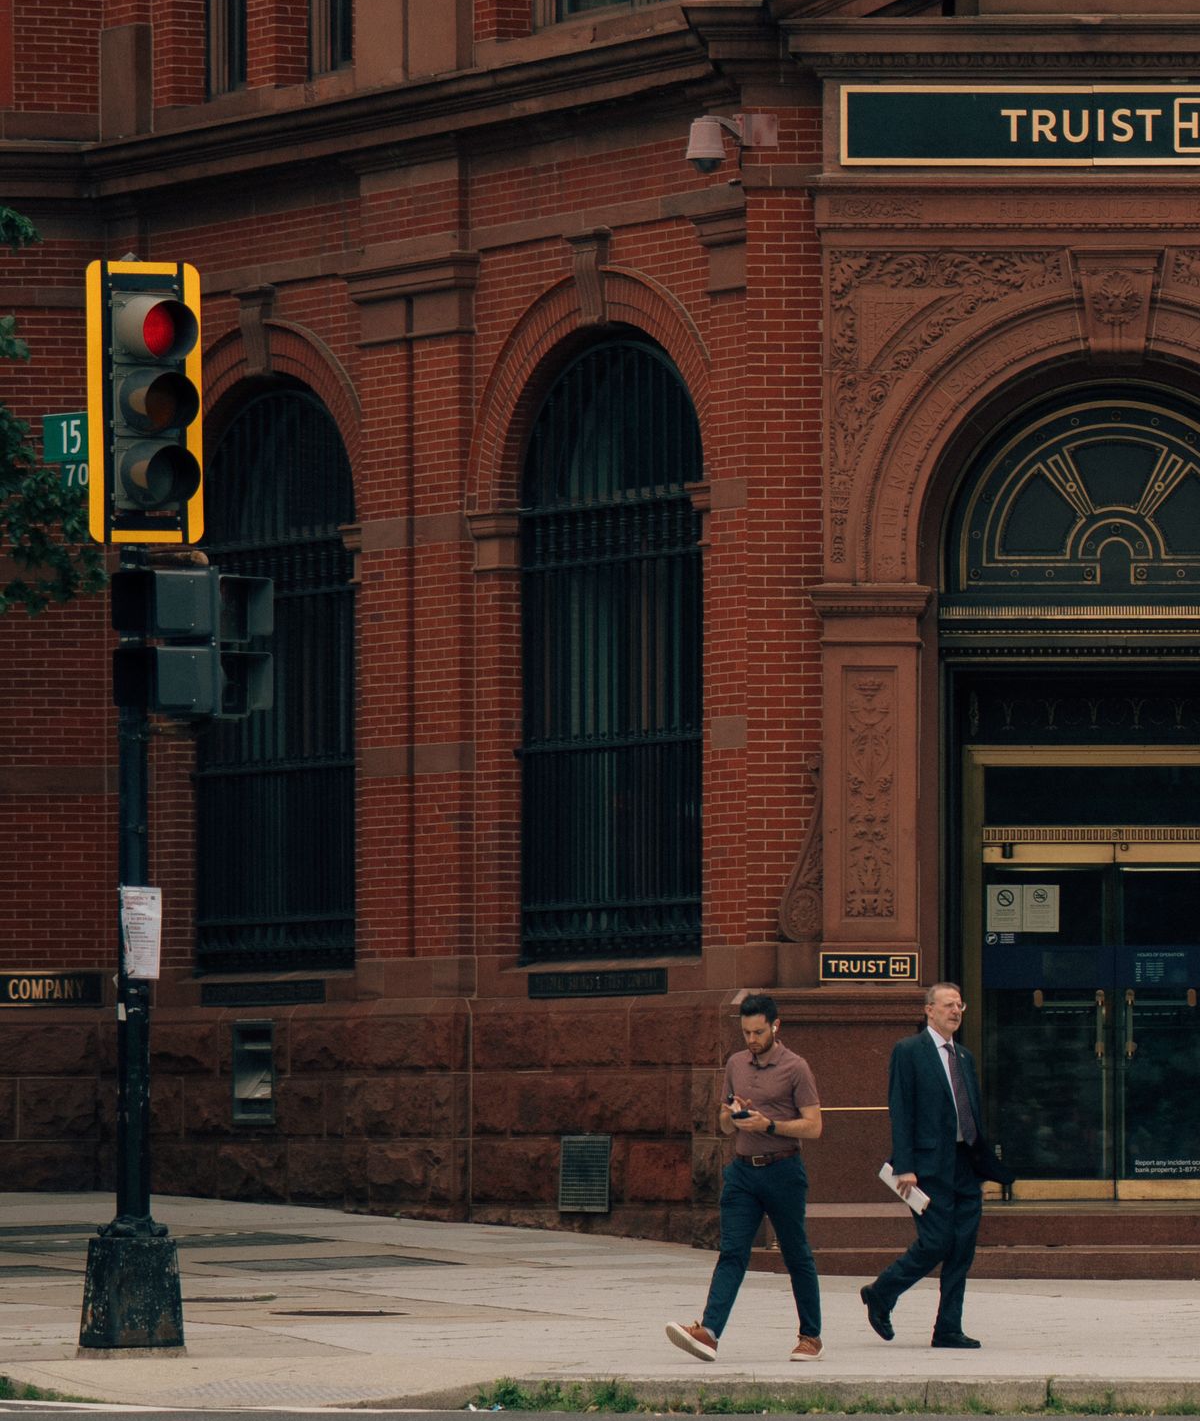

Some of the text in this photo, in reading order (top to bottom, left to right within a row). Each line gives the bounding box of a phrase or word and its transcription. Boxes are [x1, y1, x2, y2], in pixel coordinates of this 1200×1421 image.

[1001, 108, 1162, 143] TRUIST
[997, 201, 1170, 219] REORGANIZED
[886, 393, 949, 490] NATIONAL
[944, 350, 995, 396] SAFE
[60, 419, 82, 454] 15
[828, 960, 886, 975] TRUIST
[8, 978, 84, 1000] COMPANY
